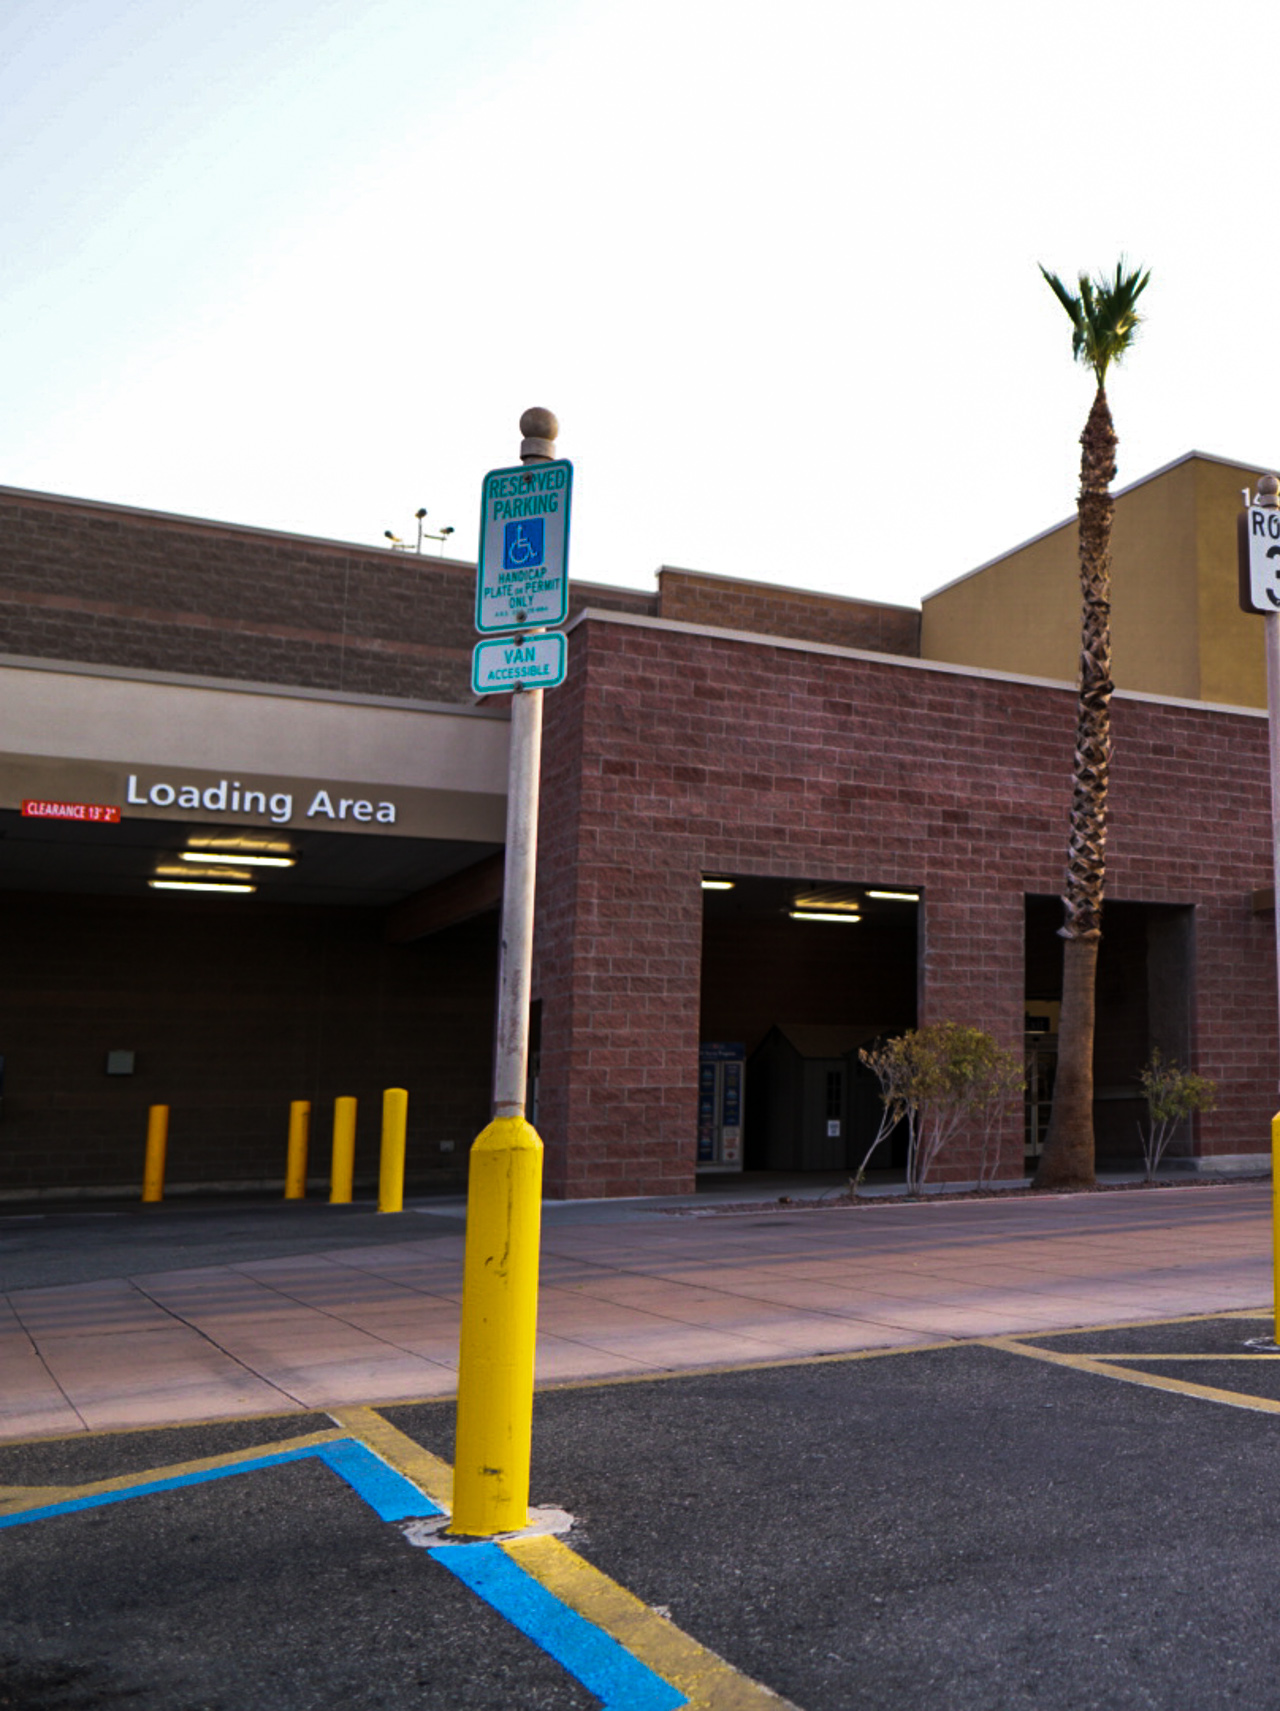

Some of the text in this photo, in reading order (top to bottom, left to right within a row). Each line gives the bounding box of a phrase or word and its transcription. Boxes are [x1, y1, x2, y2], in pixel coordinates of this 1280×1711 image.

[489, 469, 565, 498] RESERVED
[494, 492, 559, 520] PARKING
[498, 567, 547, 584] HANDICAP
[484, 584, 513, 599] PLATE
[525, 578, 560, 594] PERMIT
[509, 595, 534, 609] ONLY
[504, 646, 536, 664] VAN
[488, 664, 550, 680] ACCESSIBLE
[127, 774, 397, 823] Loading Area
[28, 802, 85, 819] CLEARANCE
